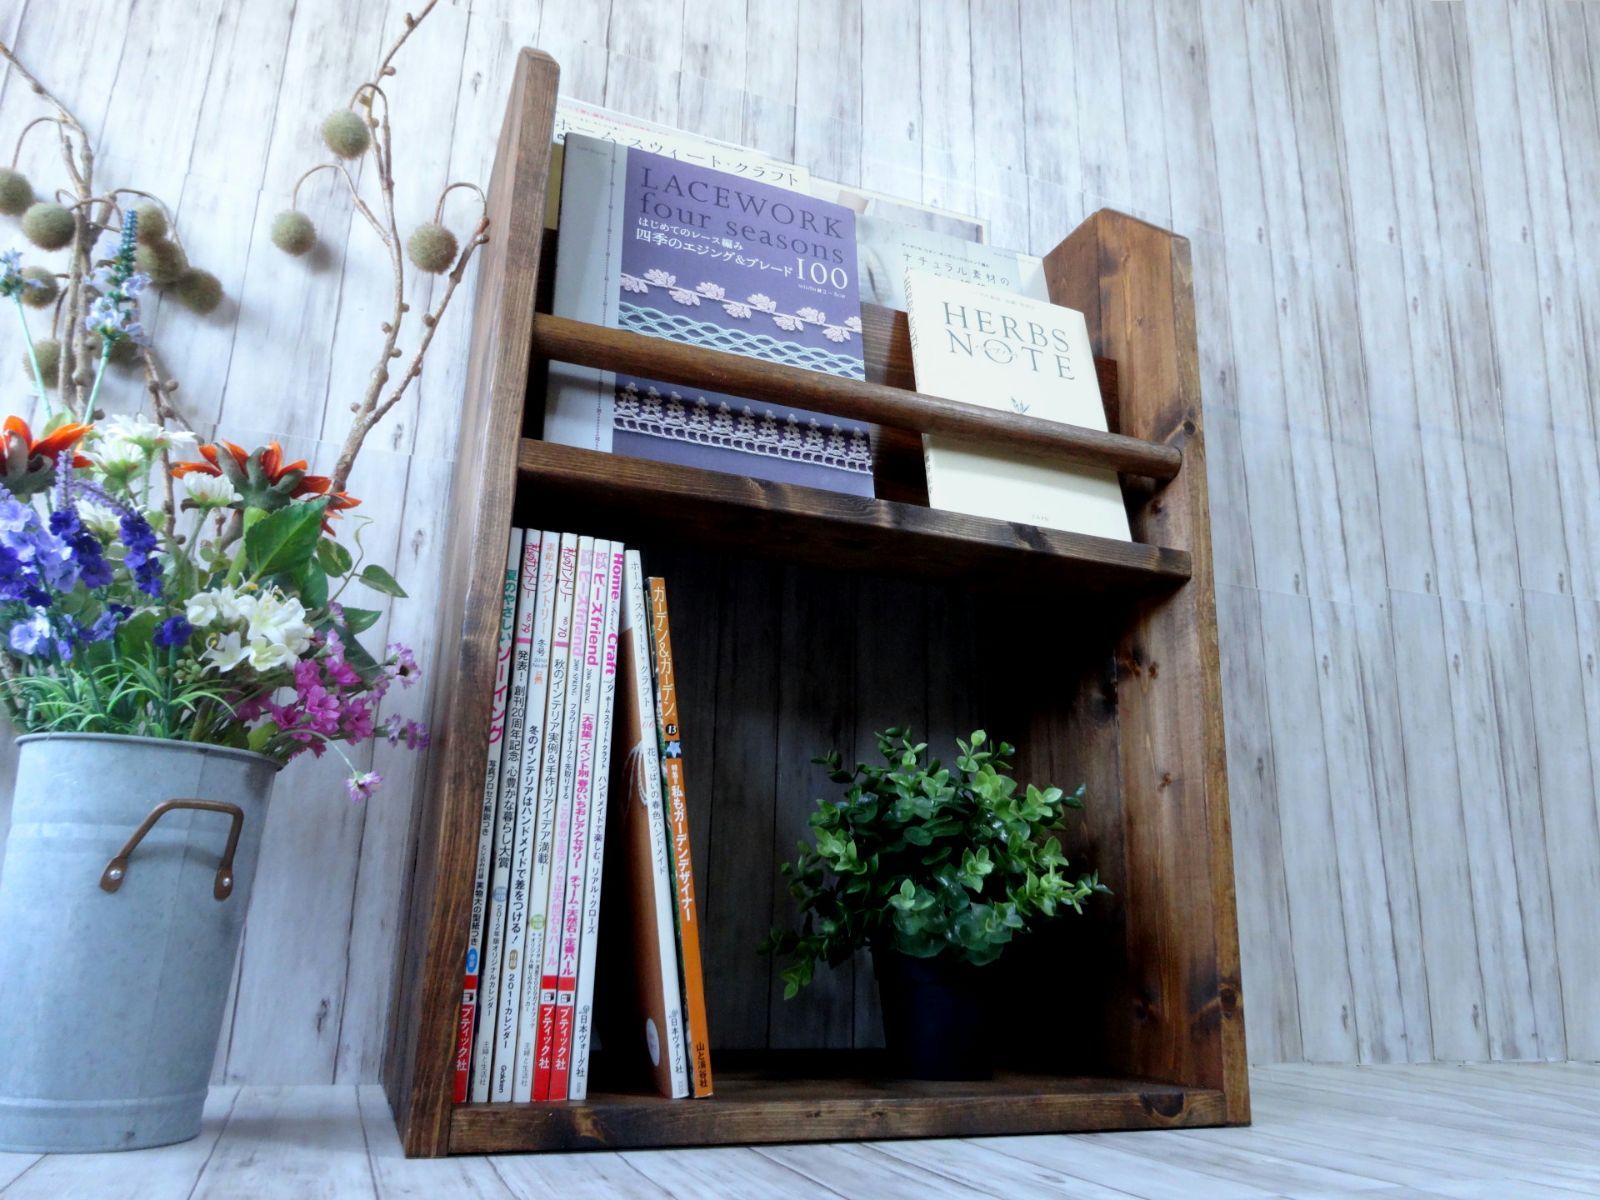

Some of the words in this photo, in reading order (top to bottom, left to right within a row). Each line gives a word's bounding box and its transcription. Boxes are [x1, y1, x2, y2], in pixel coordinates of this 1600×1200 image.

[638, 217, 743, 250] はじめてのレース編み
[639, 192, 712, 229] four
[726, 219, 844, 264] seasons
[640, 167, 844, 240] LACEWORK
[941, 301, 1070, 353] HERBS
[945, 328, 1075, 380] NOTE
[605, 633, 618, 675] Craft
[654, 586, 674, 716] ガーデン&ガーデン
[456, 1007, 473, 1071] ブティック社
[539, 1006, 554, 1069] ブティック社
[555, 1008, 570, 1071] ブティック社
